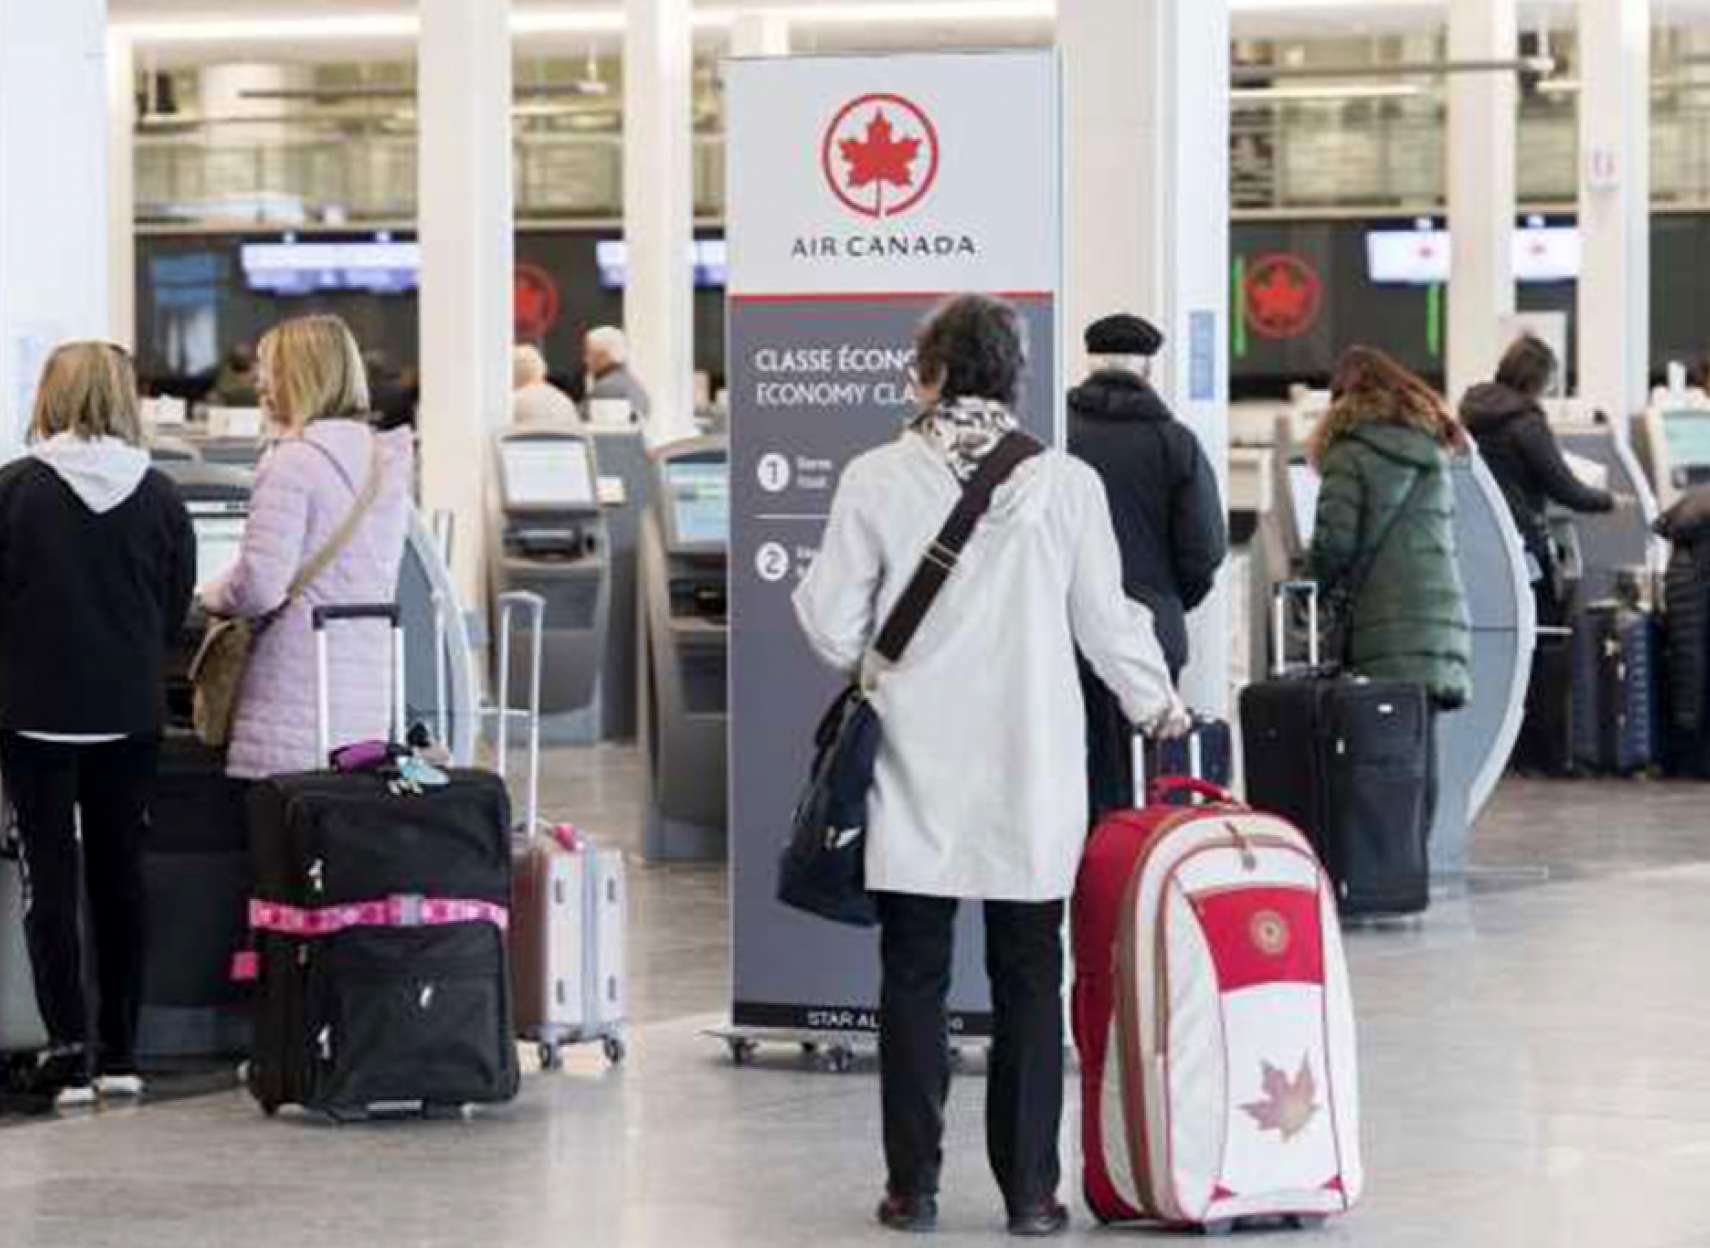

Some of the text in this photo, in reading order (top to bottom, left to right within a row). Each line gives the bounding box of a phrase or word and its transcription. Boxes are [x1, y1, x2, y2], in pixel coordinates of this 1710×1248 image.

[792, 235, 976, 257] AIR CANADA
[755, 349, 832, 371] CLASSE
[756, 383, 919, 405] ECONOMY CLA
[808, 1010, 880, 1028] STAR AL
